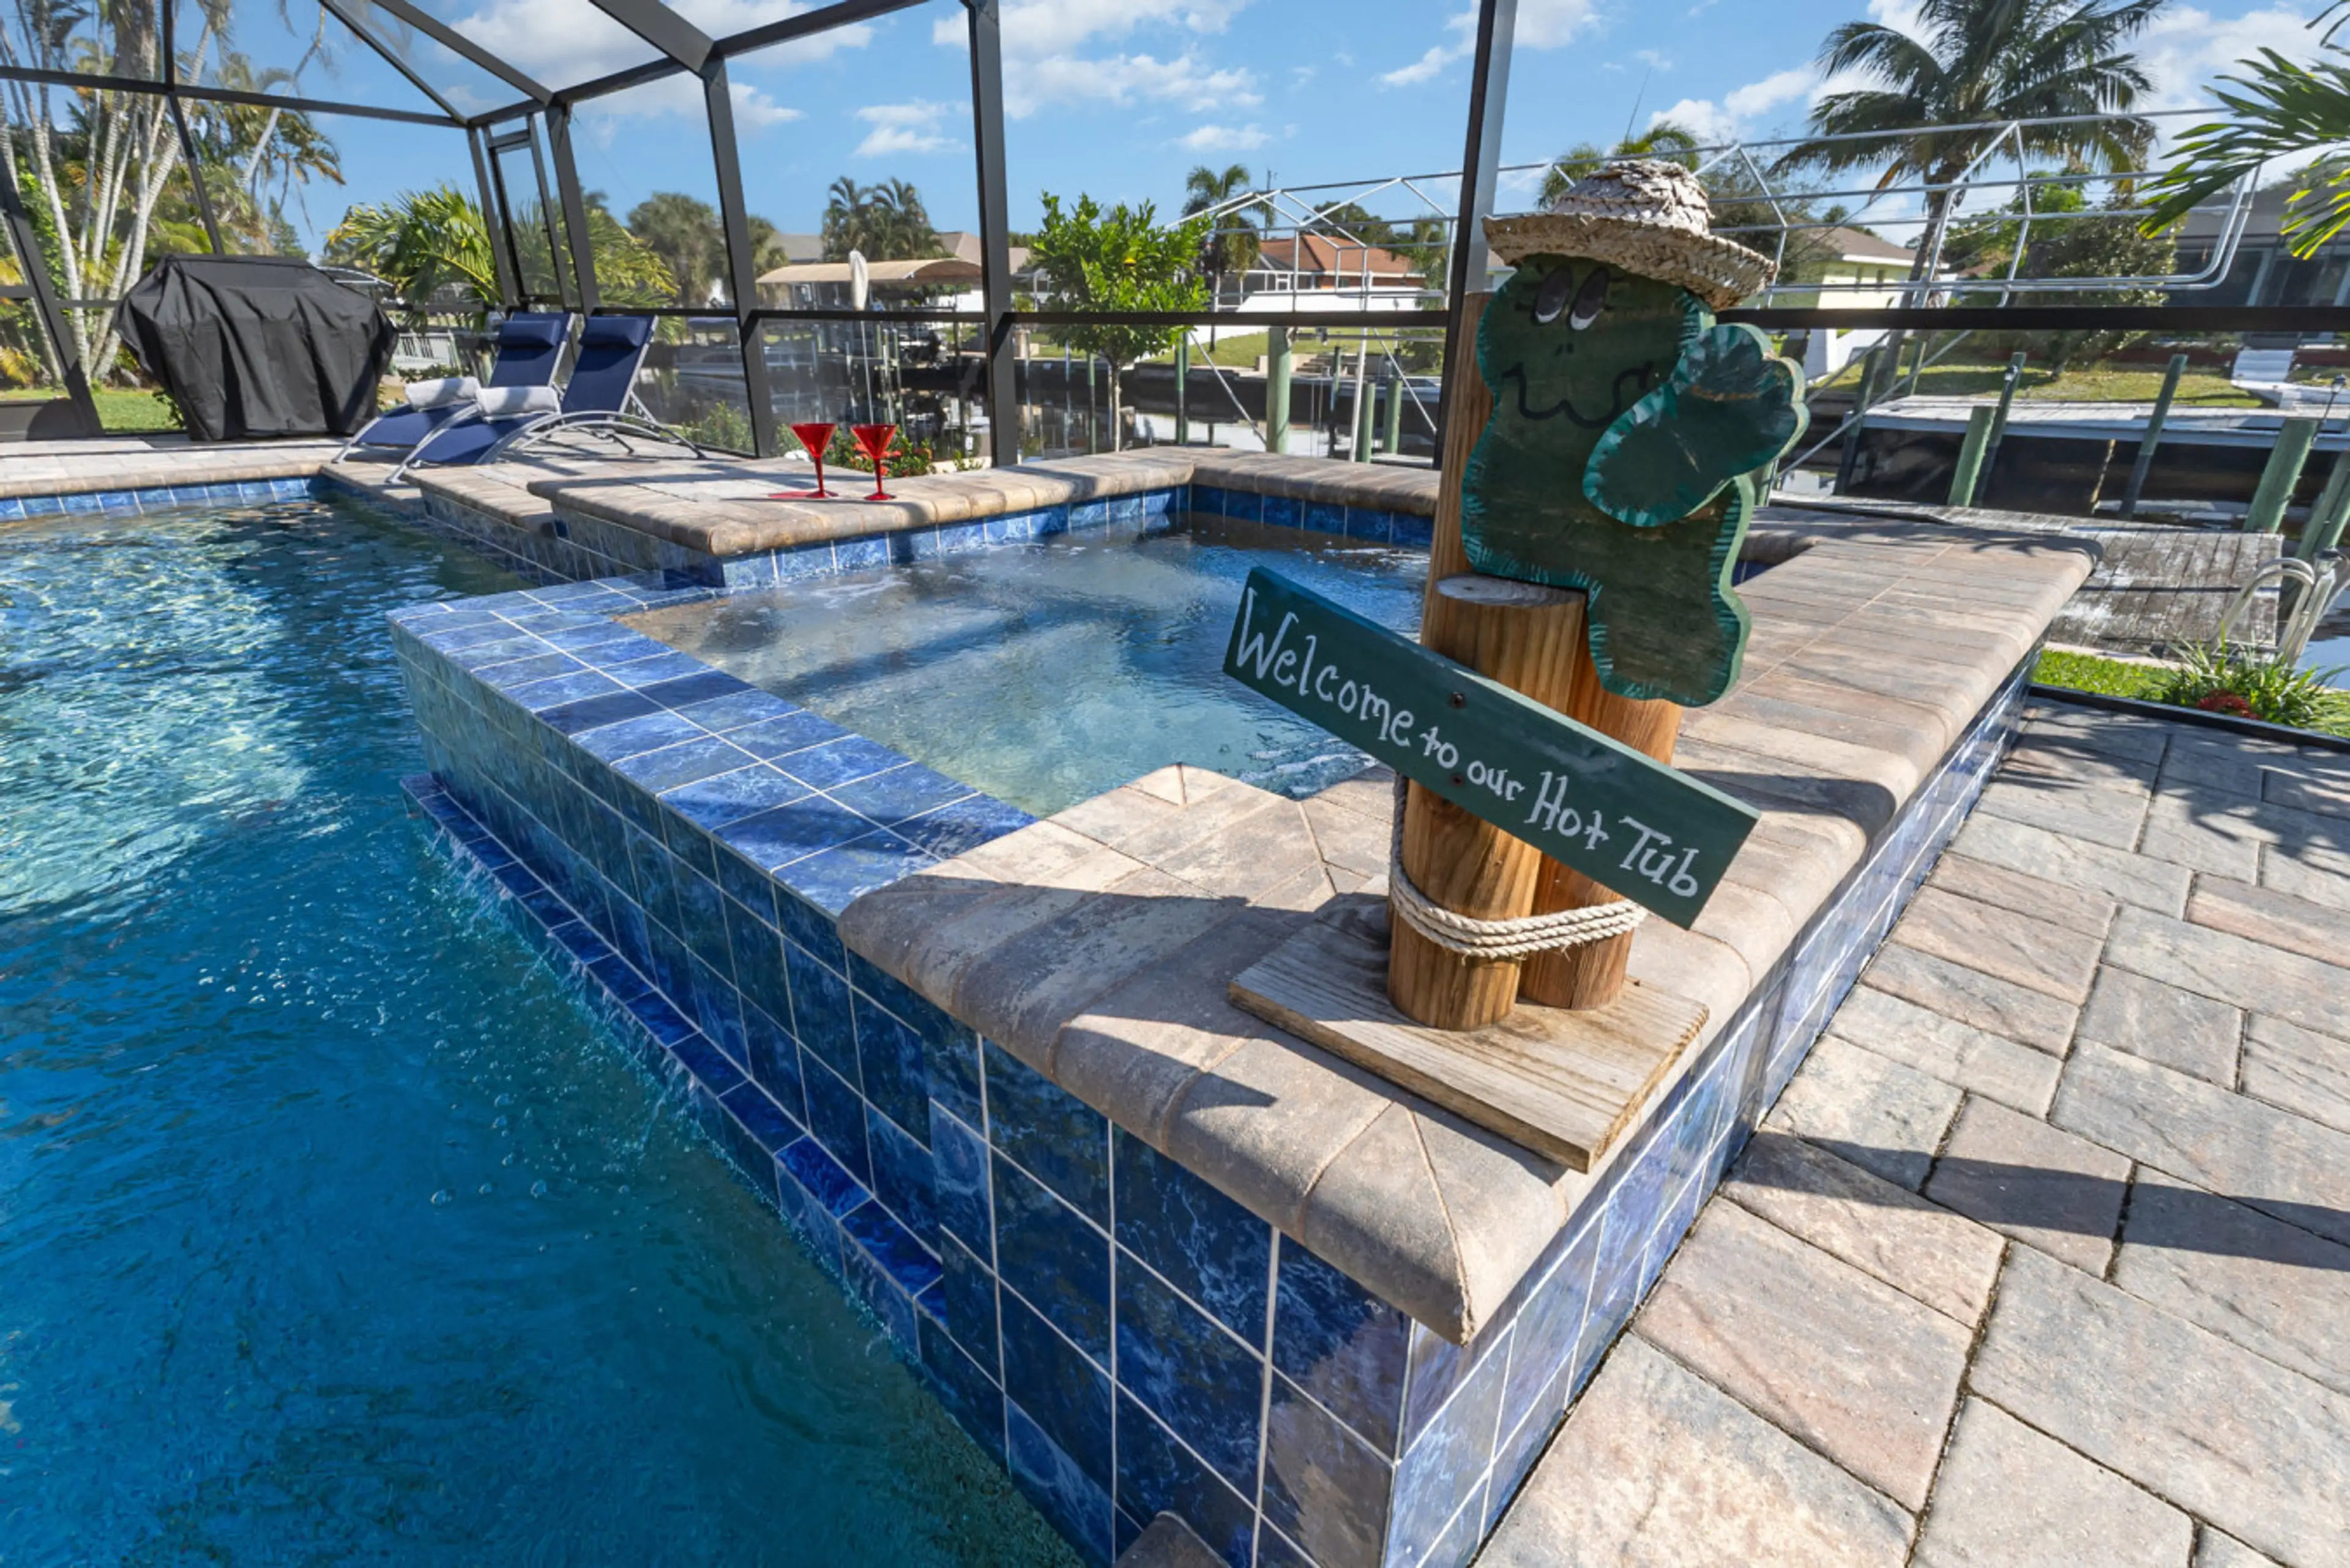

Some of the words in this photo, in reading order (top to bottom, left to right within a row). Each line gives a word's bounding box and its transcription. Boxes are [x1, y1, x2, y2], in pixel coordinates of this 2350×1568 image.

[1236, 587, 1414, 747] Welcome
[1420, 726, 1459, 770] to
[1467, 760, 1526, 801] our
[1524, 771, 1610, 850] Hot
[1618, 815, 1700, 898] Tub
